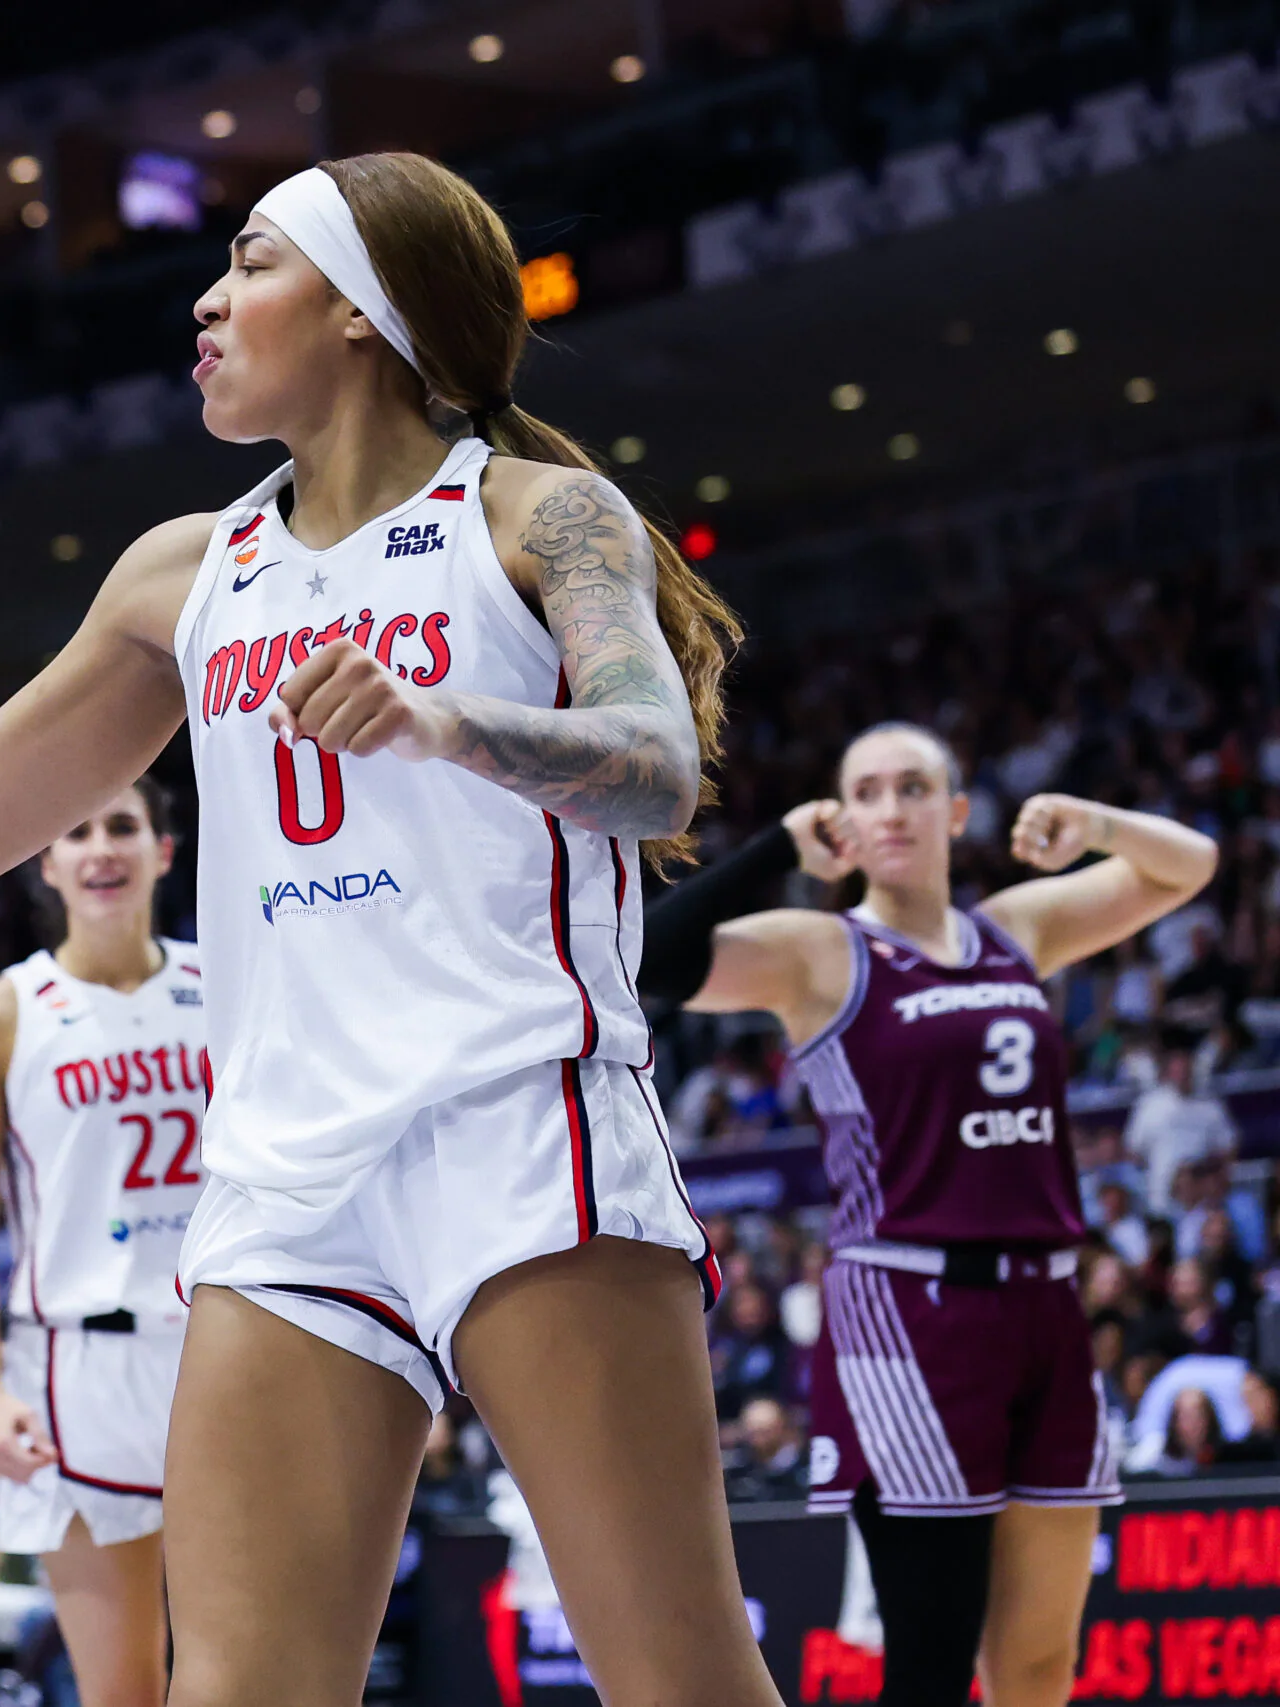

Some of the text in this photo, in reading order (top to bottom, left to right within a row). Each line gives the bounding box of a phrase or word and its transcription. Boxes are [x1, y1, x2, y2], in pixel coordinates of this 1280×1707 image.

[384, 534, 447, 560] max
[387, 522, 439, 543] CAR
[274, 734, 344, 846] 0
[260, 868, 402, 916] VANDA
[979, 1018, 1036, 1098] 3
[119, 1109, 200, 1190] 22
